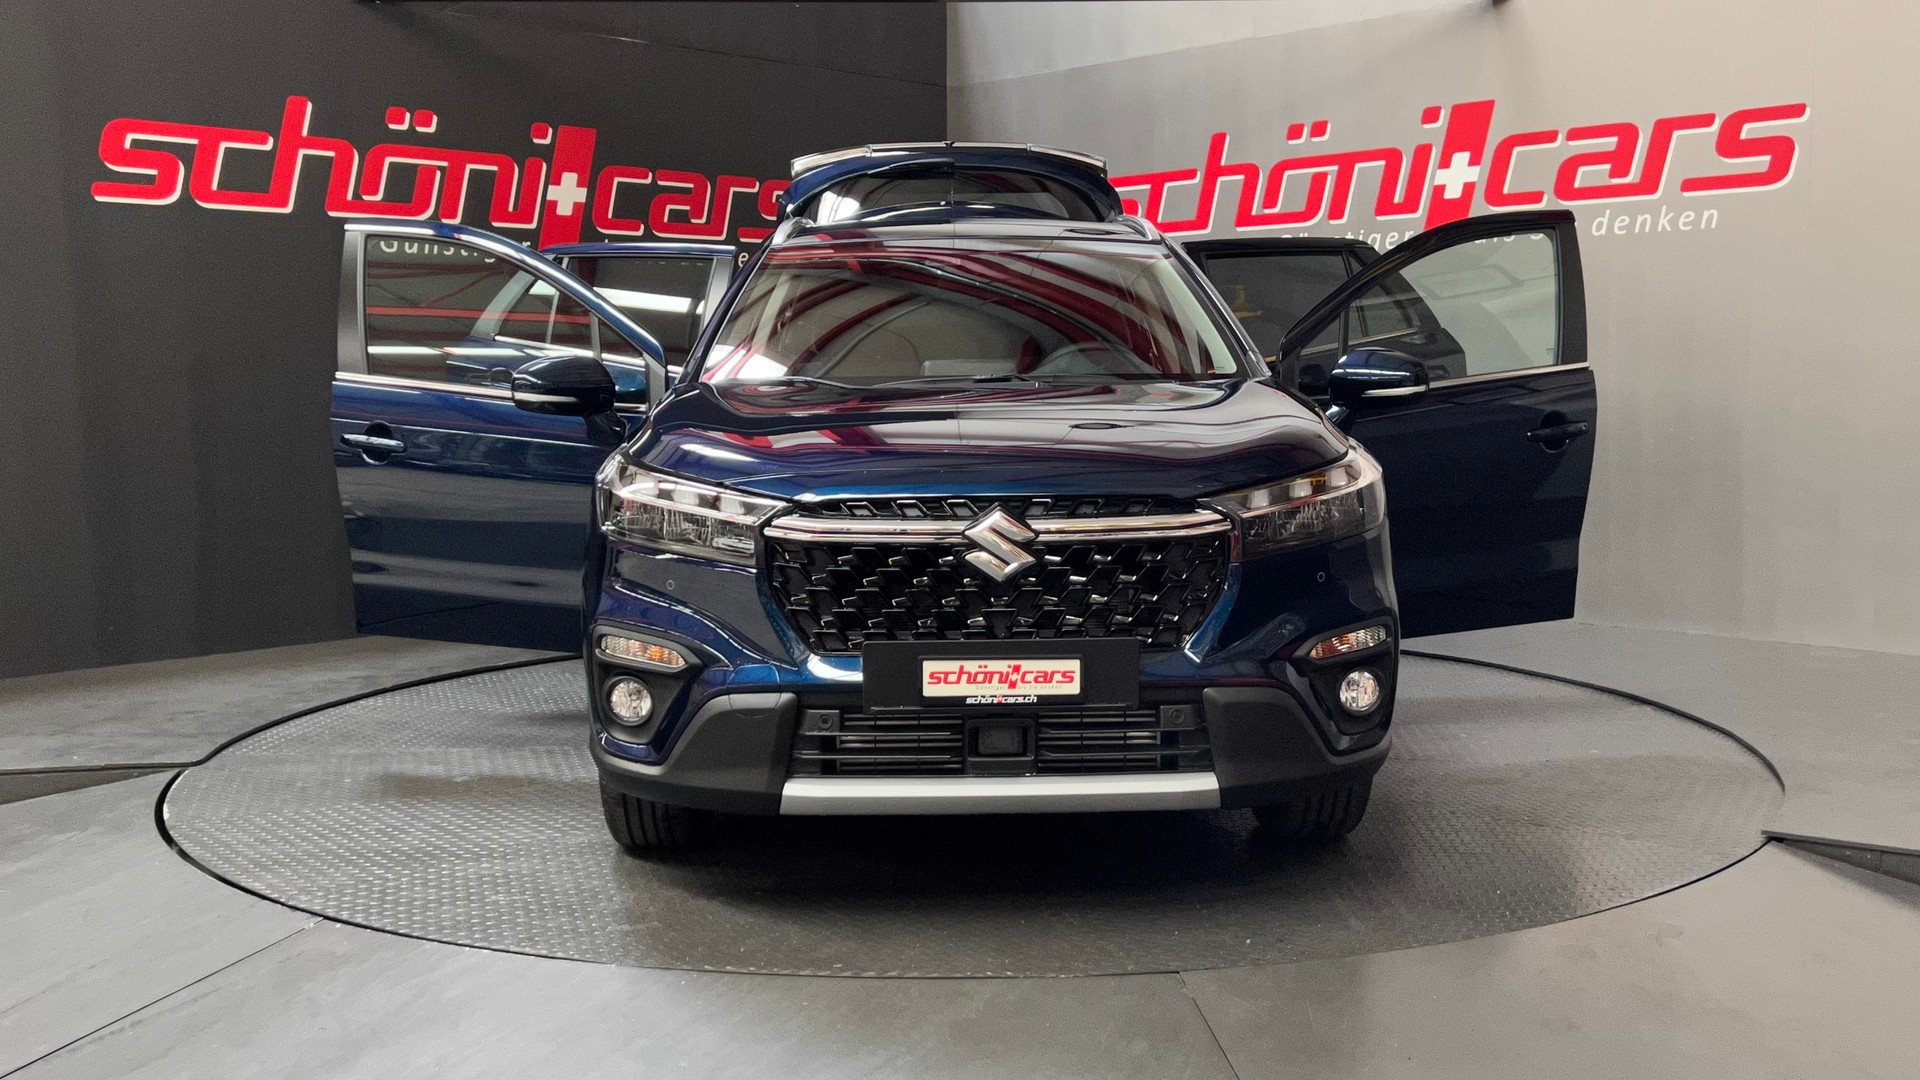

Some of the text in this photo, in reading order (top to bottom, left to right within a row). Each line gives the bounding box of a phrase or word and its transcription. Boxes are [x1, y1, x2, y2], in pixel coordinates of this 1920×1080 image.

[1108, 102, 1810, 234] chöni cars
[1591, 205, 1719, 237] denken
